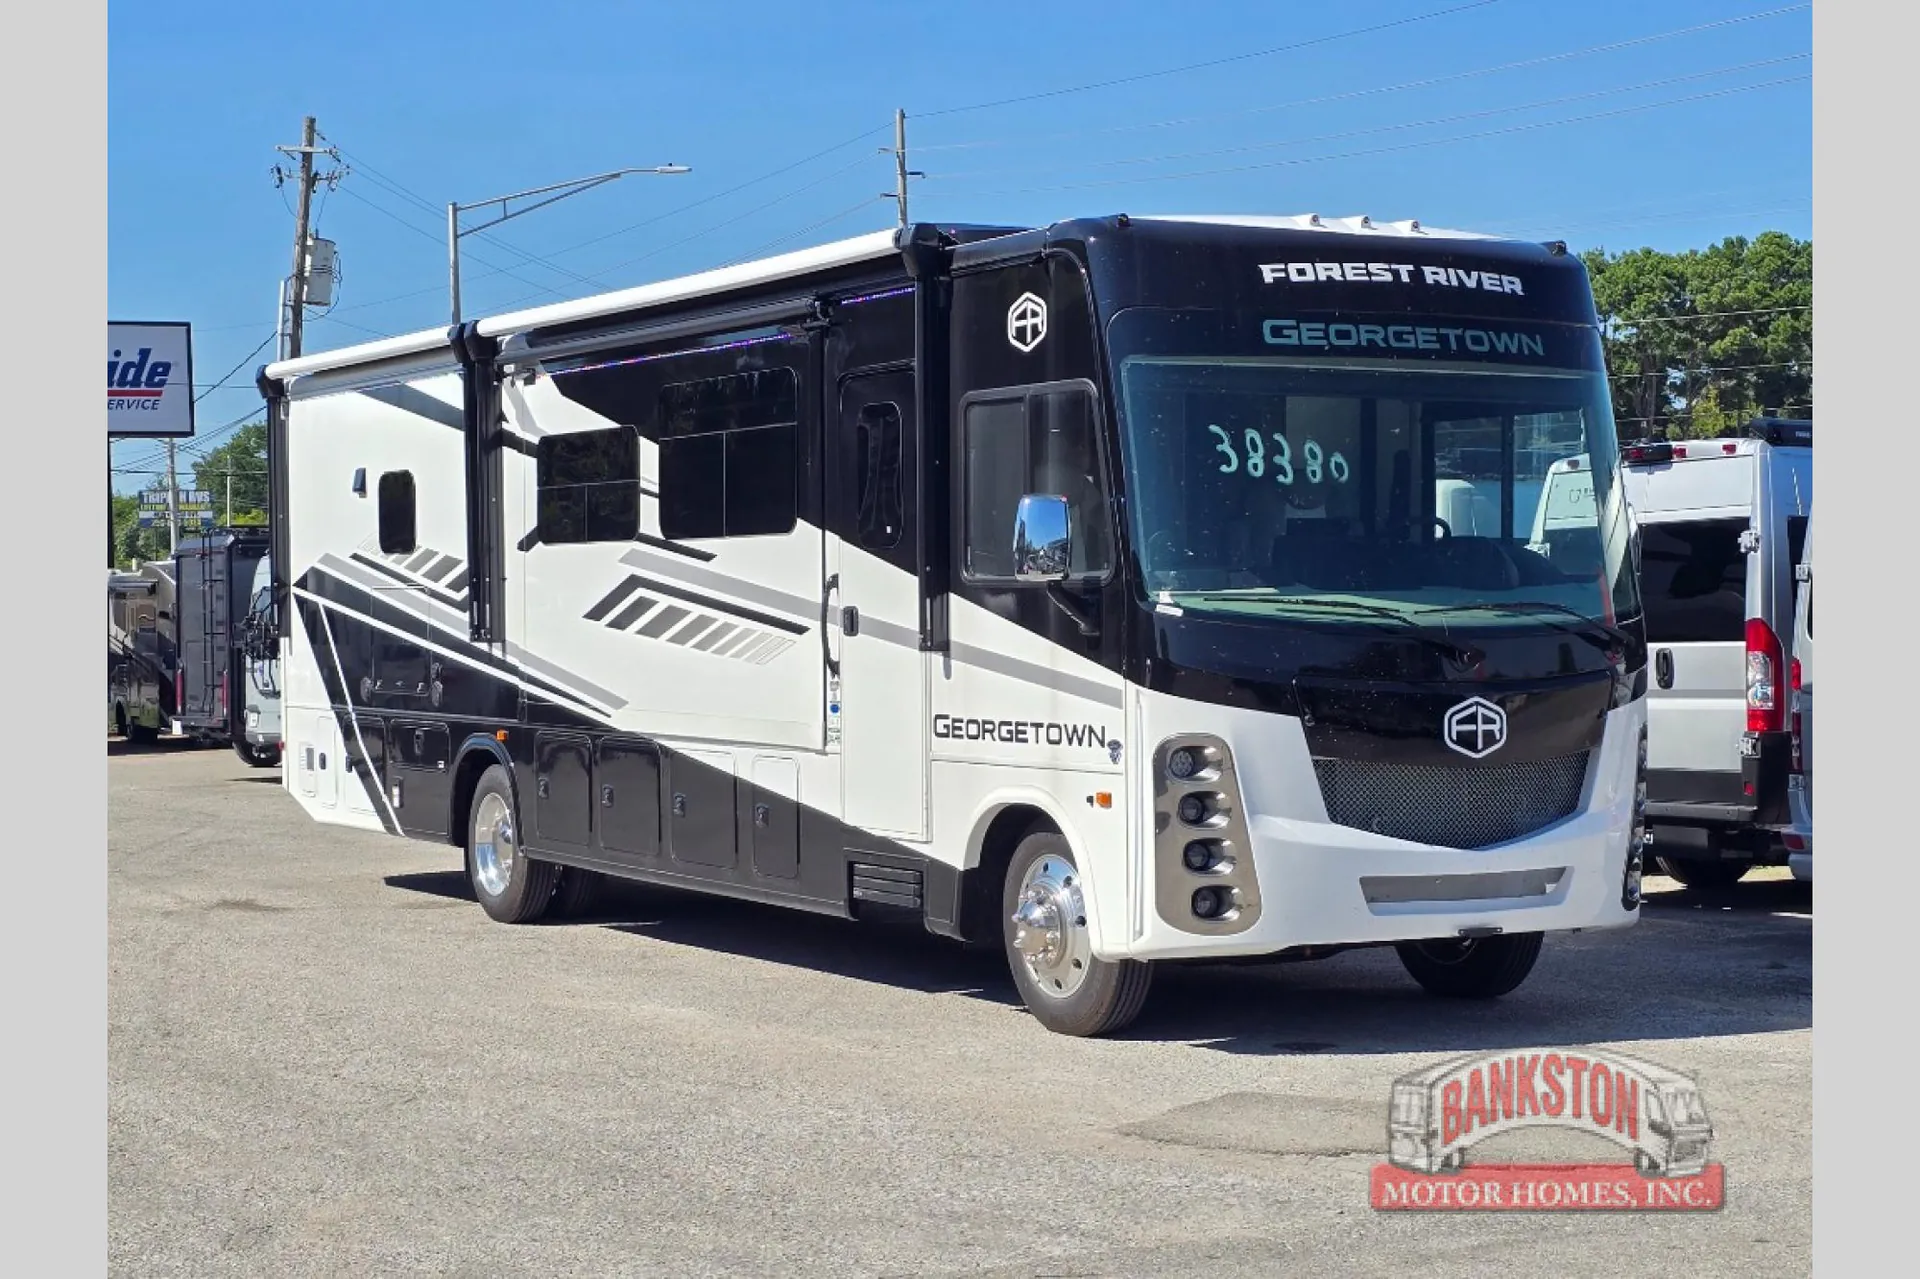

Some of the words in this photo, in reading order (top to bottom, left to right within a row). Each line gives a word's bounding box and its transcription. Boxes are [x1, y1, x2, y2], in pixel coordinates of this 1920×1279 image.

[1259, 262, 1414, 287] FOREST
[1419, 265, 1525, 296] RIVER
[1261, 318, 1545, 357] GEORGETOWN
[1207, 424, 1350, 486] 38380
[933, 714, 1107, 749] GEORGETOWN
